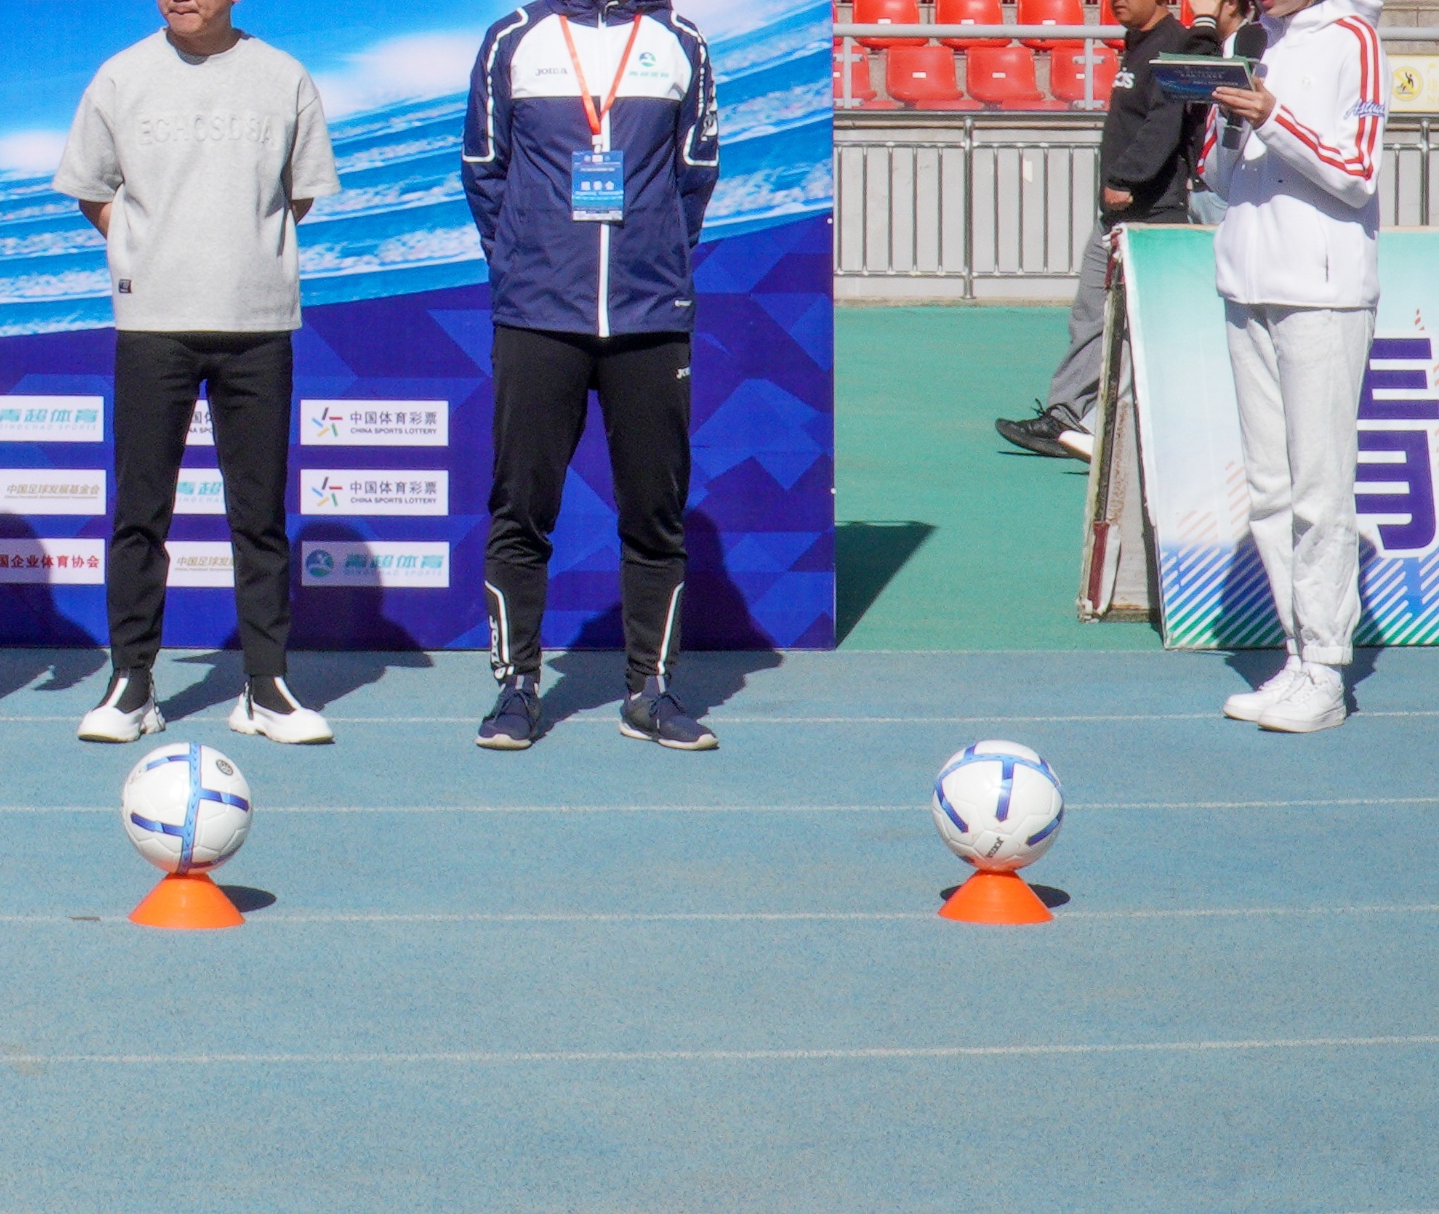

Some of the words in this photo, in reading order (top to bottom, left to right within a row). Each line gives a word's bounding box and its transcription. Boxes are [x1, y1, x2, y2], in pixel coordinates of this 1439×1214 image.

[350, 411, 438, 425] 中国体育彩票
[6, 484, 100, 495] 中国足球发展基金会
[350, 481, 438, 495] 中国体育彩票
[344, 554, 444, 569] 青超体育
